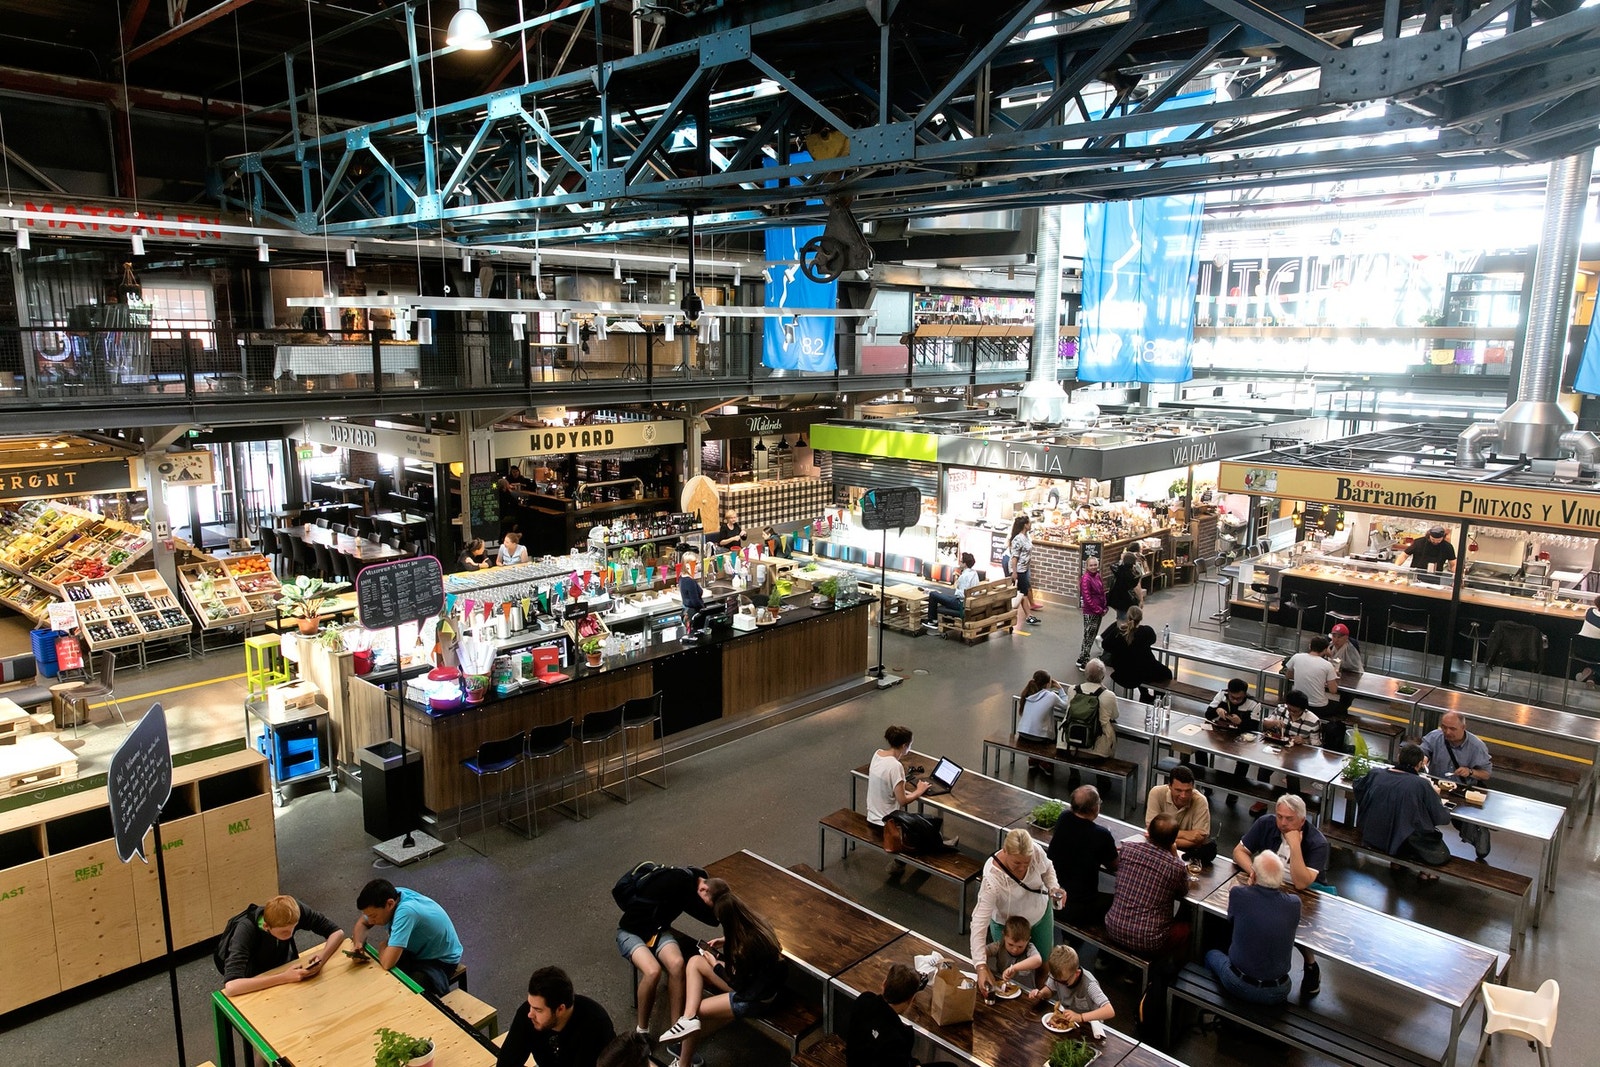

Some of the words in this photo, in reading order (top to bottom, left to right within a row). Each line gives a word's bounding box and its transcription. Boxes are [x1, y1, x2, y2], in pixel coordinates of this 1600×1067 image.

[25, 201, 222, 239] MATSALEN
[802, 337, 824, 355] 8.2
[746, 415, 782, 431] Mildrids
[330, 425, 376, 447] HOPYARD
[530, 429, 614, 451] HOPYARD
[970, 442, 1000, 466] VIA
[1005, 442, 1063, 474] ITALIA
[1172, 445, 1188, 465] VIA
[1190, 440, 1217, 462] ITALIA
[1335, 477, 1437, 510] Barramón
[1459, 490, 1532, 520] PINTXOS
[1542, 504, 1552, 521] Y
[228, 817, 250, 832] MAT
[153, 839, 184, 854] APIR
[75, 862, 105, 878] REST
